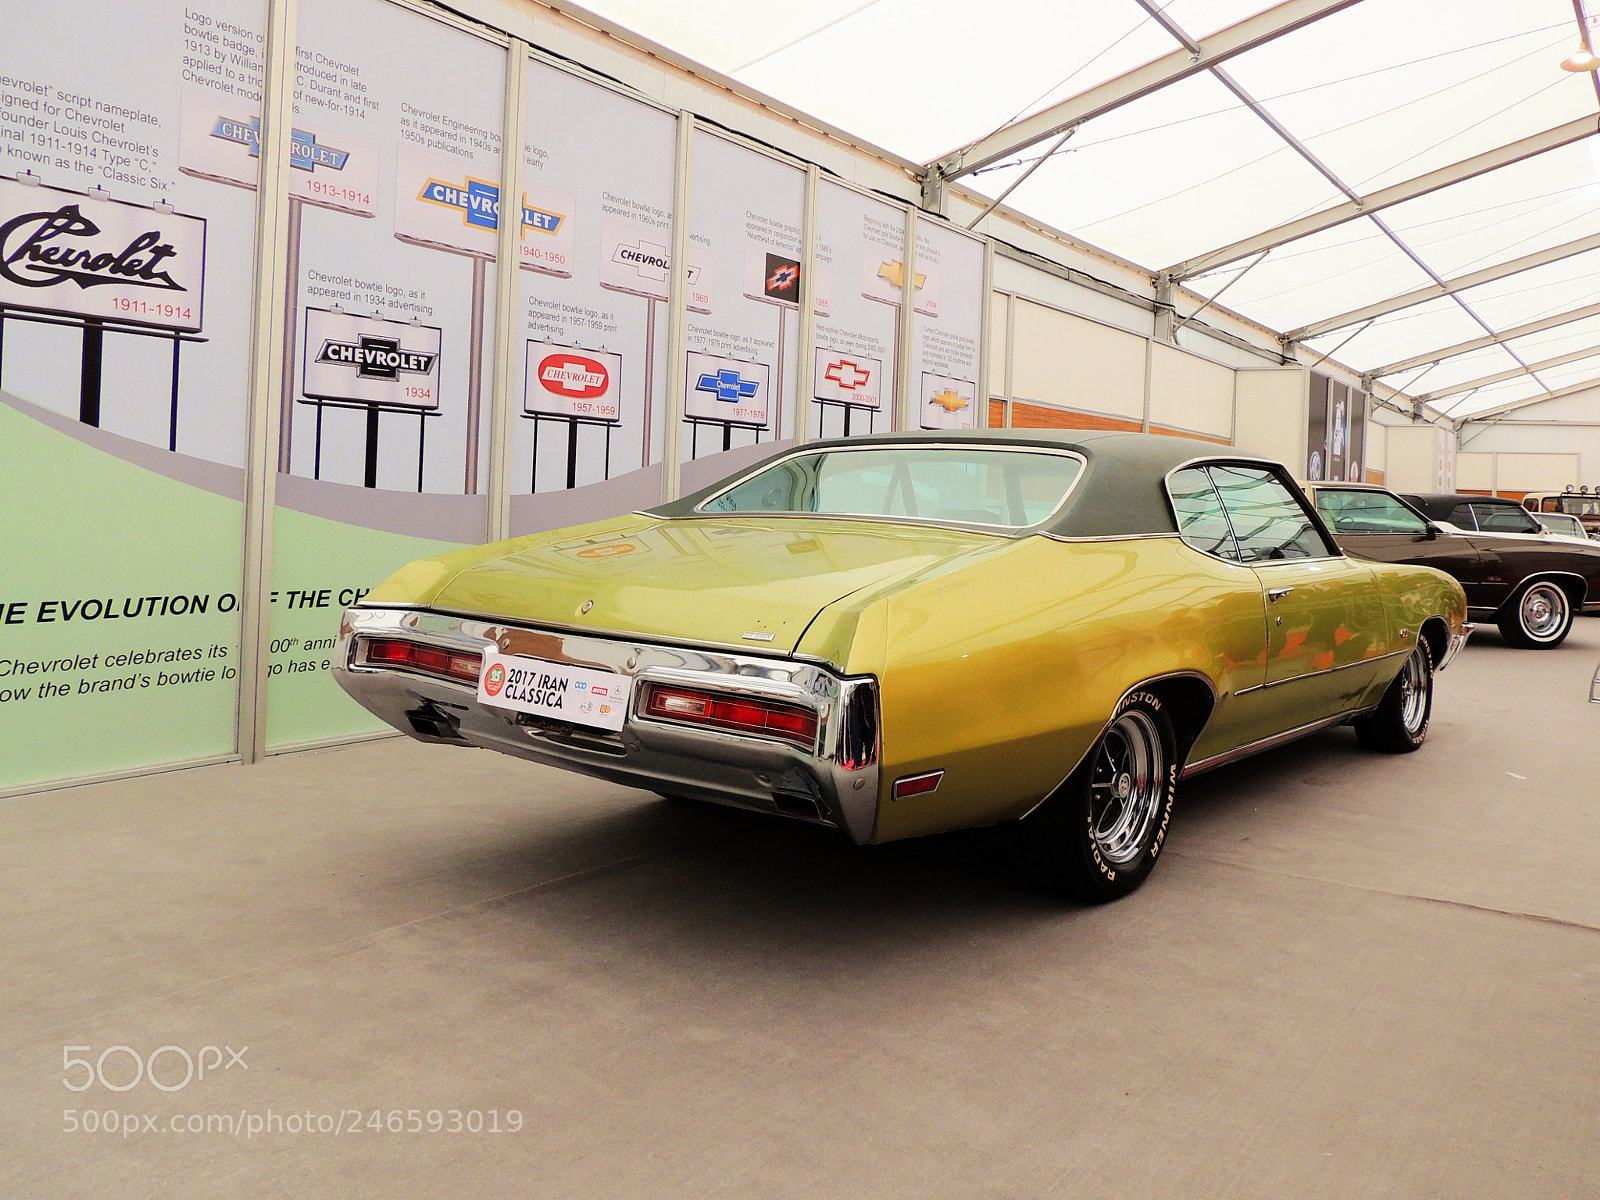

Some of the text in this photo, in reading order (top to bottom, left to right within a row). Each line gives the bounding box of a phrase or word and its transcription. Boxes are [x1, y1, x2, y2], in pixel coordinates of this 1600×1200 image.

[184, 7, 212, 26] Logo
[215, 20, 253, 40] version
[295, 45, 313, 61] first
[315, 53, 360, 77] Chevrolet
[184, 22, 219, 44] bowtie
[222, 36, 258, 58] badge,
[340, 75, 348, 87] in
[350, 77, 367, 93] late
[182, 69, 234, 95] Chevrolet
[182, 55, 222, 75] applied
[225, 66, 235, 79] to
[238, 72, 245, 82] a
[293, 90, 303, 101] of
[305, 93, 366, 119] new-for-1914
[184, 38, 211, 56] 1913
[214, 48, 227, 64] by
[296, 75, 307, 88] C.
[310, 79, 341, 99] Durant
[344, 91, 360, 106] and
[363, 96, 380, 111] first
[0, 75, 162, 128] evrolet” script nameplate,
[43, 101, 61, 116] for
[65, 107, 125, 133] Chevrolet
[400, 102, 440, 124] Chevrolet
[442, 115, 488, 141] Engineering
[532, 145, 549, 160] logo,
[0, 126, 25, 142] inal
[30, 133, 97, 159] 1911-1914
[102, 149, 131, 167] Type
[53, 121, 87, 140] Louis
[92, 131, 159, 157] Chevrolet’s
[400, 116, 410, 127] as
[412, 118, 418, 129] it
[419, 122, 458, 142] appeared
[459, 132, 467, 144] in
[469, 136, 493, 152] 1940s
[526, 157, 544, 171] early
[400, 128, 476, 160] 1950s publications.
[7, 144, 50, 165] known
[55, 158, 70, 169] as
[74, 160, 94, 175] the
[306, 180, 370, 205] 1913-1914
[602, 191, 631, 208] Chevrolet
[632, 201, 651, 214] bowtie
[602, 203, 630, 219] appeared
[631, 210, 637, 220] in
[0, 204, 187, 292] Chevrolet
[519, 245, 566, 265] 1940-1950
[620, 249, 694, 279] CHEVROLT
[308, 269, 426, 300] Chevrolet bowtie logo, as it
[692, 292, 709, 303] 1960
[112, 297, 192, 320] 1911-1914
[307, 285, 436, 317] appeared in 1934 advertising.
[529, 295, 561, 310] Chevrolet
[562, 302, 583, 315] bowtie
[584, 307, 600, 319] logo,
[528, 309, 618, 333] appeared in 1957-1959 print
[528, 321, 565, 336] advertising.
[688, 324, 712, 335] Chevrolet
[327, 345, 428, 371] CHEVROLET
[547, 369, 602, 384] CHEVROLET
[716, 380, 741, 391] Chevrolet
[405, 386, 431, 399] 1934
[851, 393, 877, 403] 2000-2001
[572, 402, 616, 416] 1957-1959
[732, 407, 765, 418] 1977-1979
[36, 595, 210, 623] EVOLUTION
[286, 590, 332, 609] THE
[0, 654, 99, 677] Chevrolet
[104, 647, 203, 668] celebrates
[207, 644, 228, 659] its
[38, 682, 71, 699] the
[78, 673, 151, 695] brand’s
[157, 667, 216, 687] bowtie
[288, 660, 316, 674] has
[507, 669, 536, 687] 2017
[538, 673, 569, 693] IRAN
[505, 684, 563, 709] CLASSICA
[1151, 763, 1177, 858] WINNER
